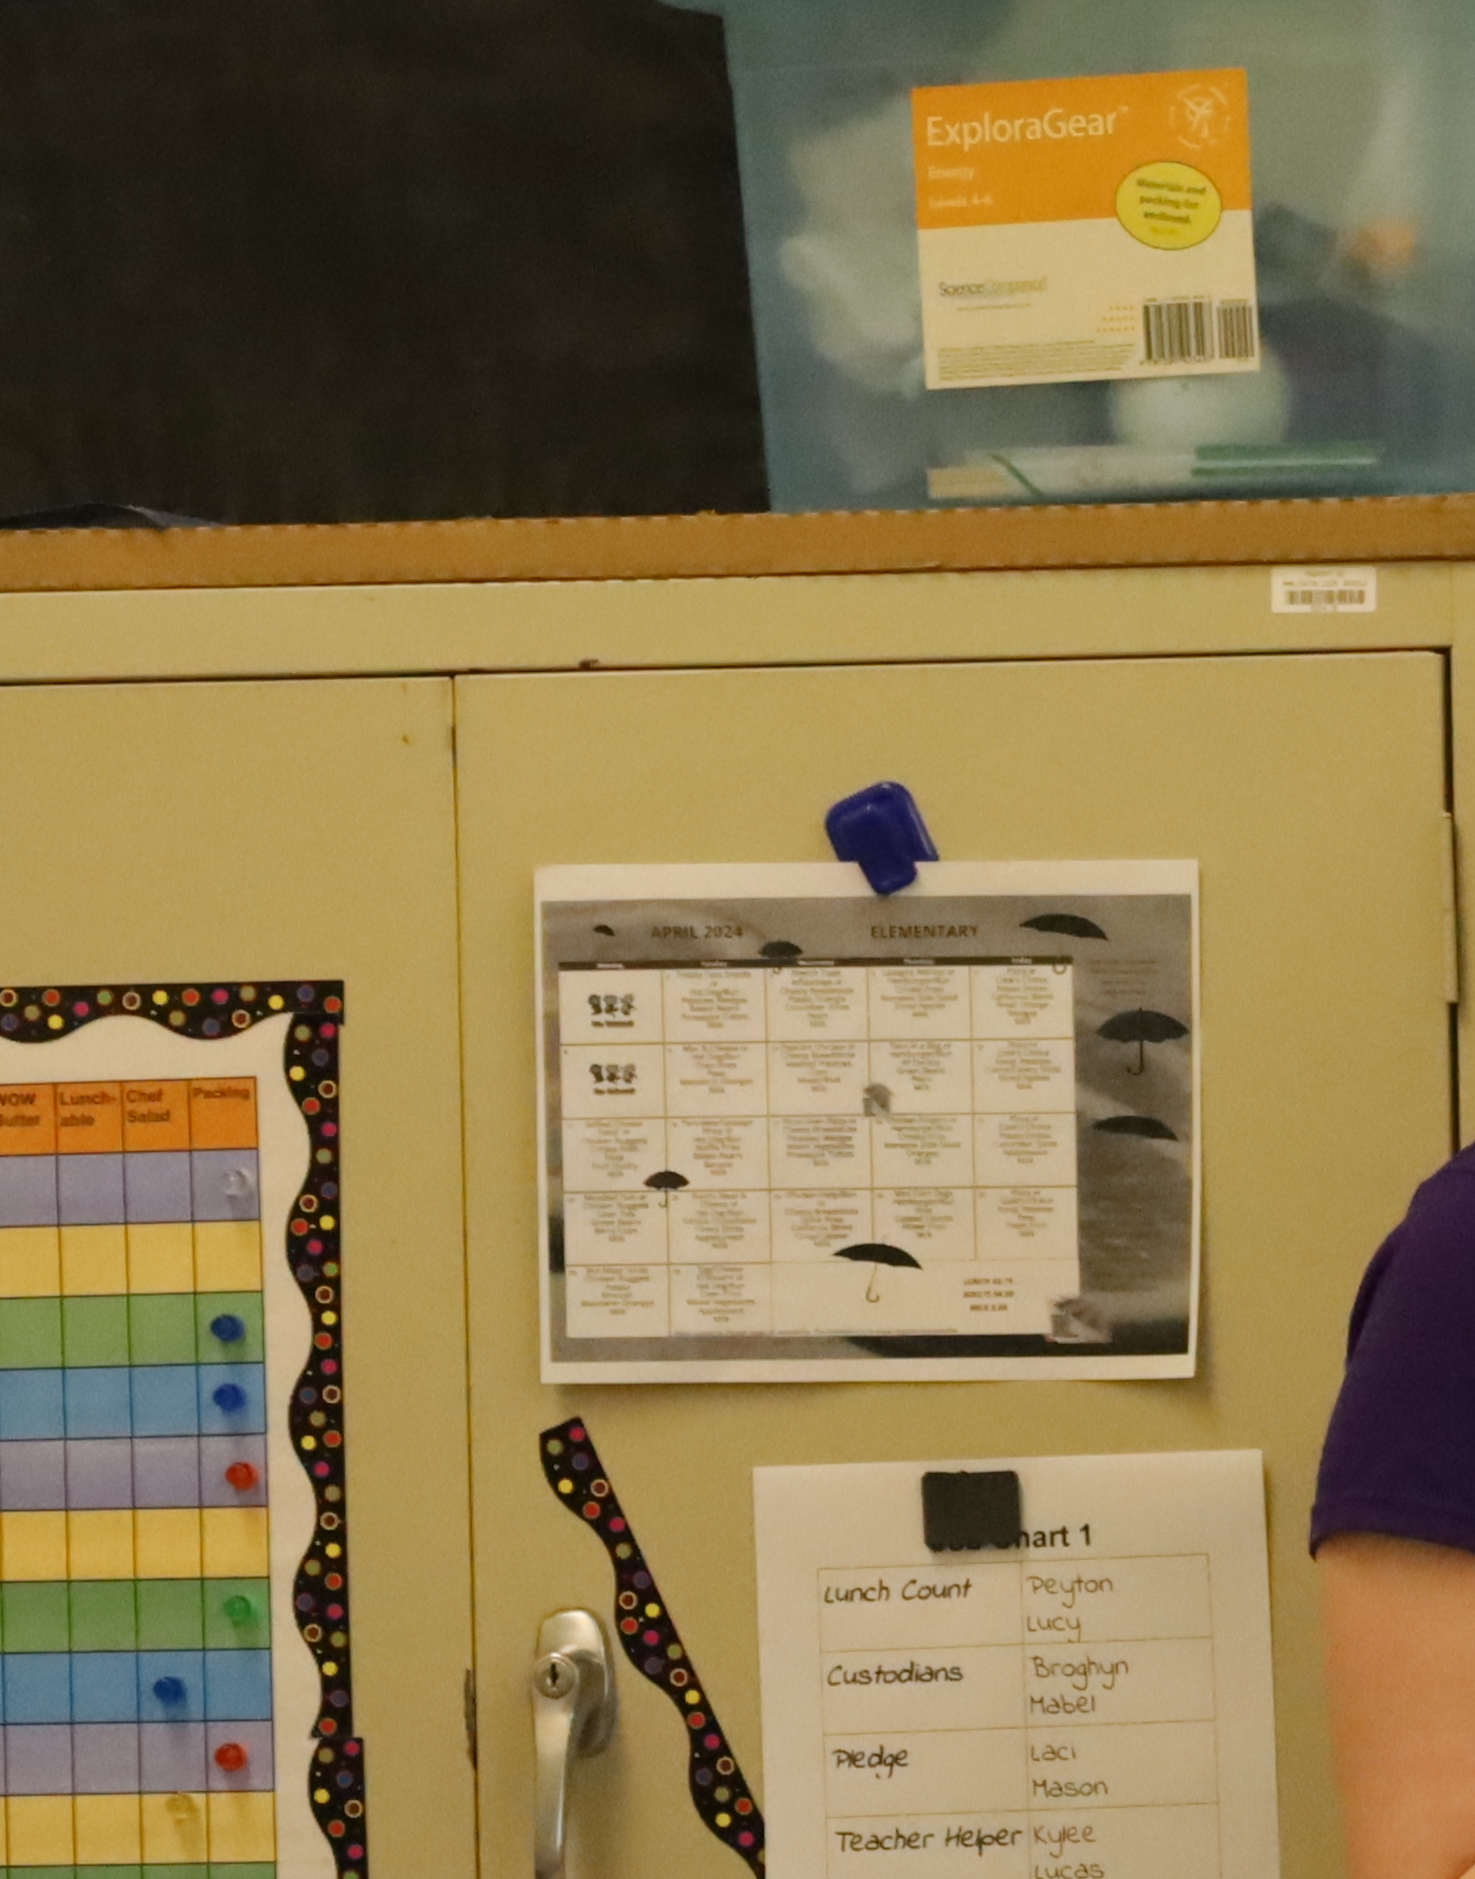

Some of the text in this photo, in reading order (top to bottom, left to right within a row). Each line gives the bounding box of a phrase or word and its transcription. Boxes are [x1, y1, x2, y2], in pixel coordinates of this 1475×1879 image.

[651, 924, 744, 940] APRIL 2024
[870, 925, 979, 940] ELEMENTARY
[1078, 1524, 1093, 1548] 1
[824, 1577, 973, 1605] Lunch Count
[1025, 1572, 1115, 1609] Peyton
[1026, 1614, 1082, 1644] Lucy
[827, 1661, 965, 1690] Custodians
[1030, 1693, 1098, 1717] Mabel
[832, 1747, 911, 1780] Pledge
[1031, 1778, 1110, 1799] Mason
[833, 1826, 1024, 1859] Teacher Helper
[1032, 1823, 1097, 1859] Kylee
